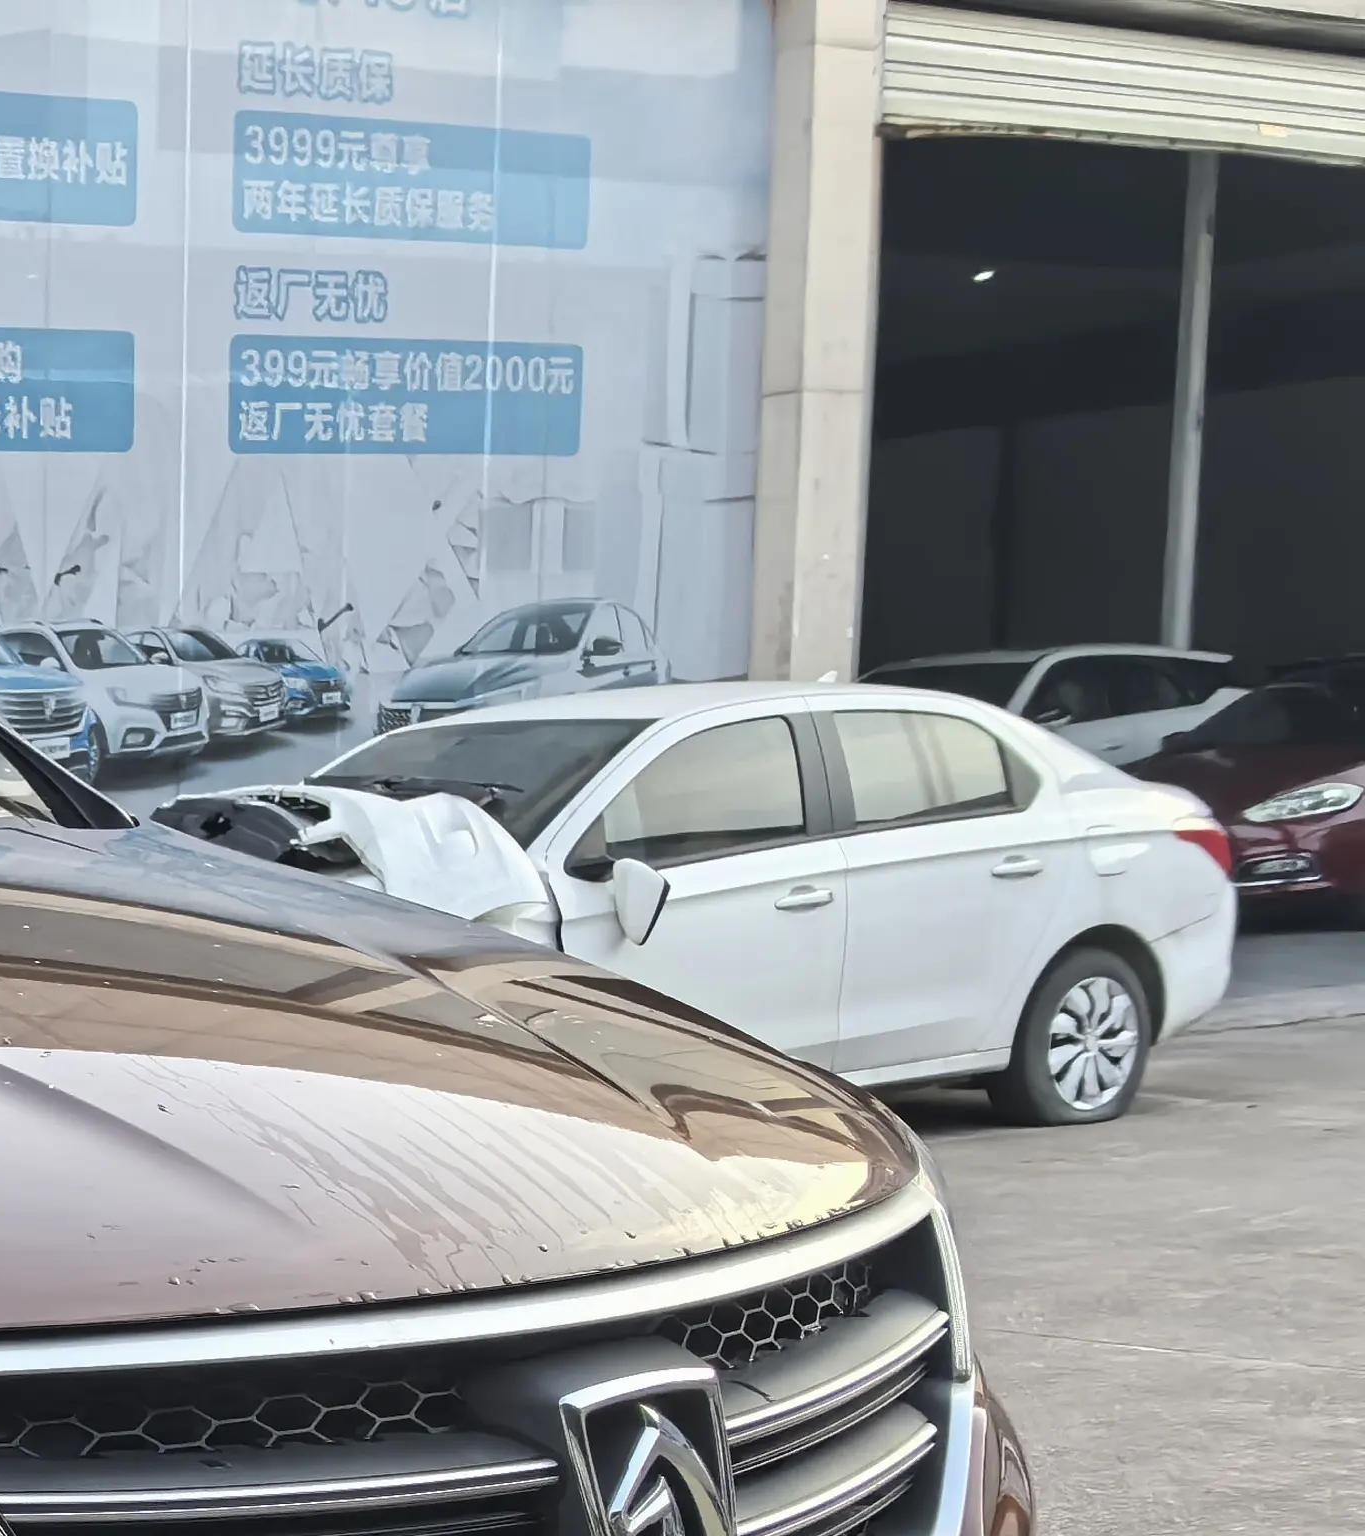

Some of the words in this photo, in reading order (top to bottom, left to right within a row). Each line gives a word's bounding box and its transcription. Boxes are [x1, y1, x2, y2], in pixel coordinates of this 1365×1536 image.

[238, 41, 395, 102] 延长质保
[242, 124, 432, 176] 3999元尊享
[241, 179, 495, 232] 两年延长质保服务
[234, 266, 388, 323] 返厂无忧
[239, 348, 575, 395] 399元畅享价值2000元
[237, 400, 429, 444] 返厂无忧套餐
